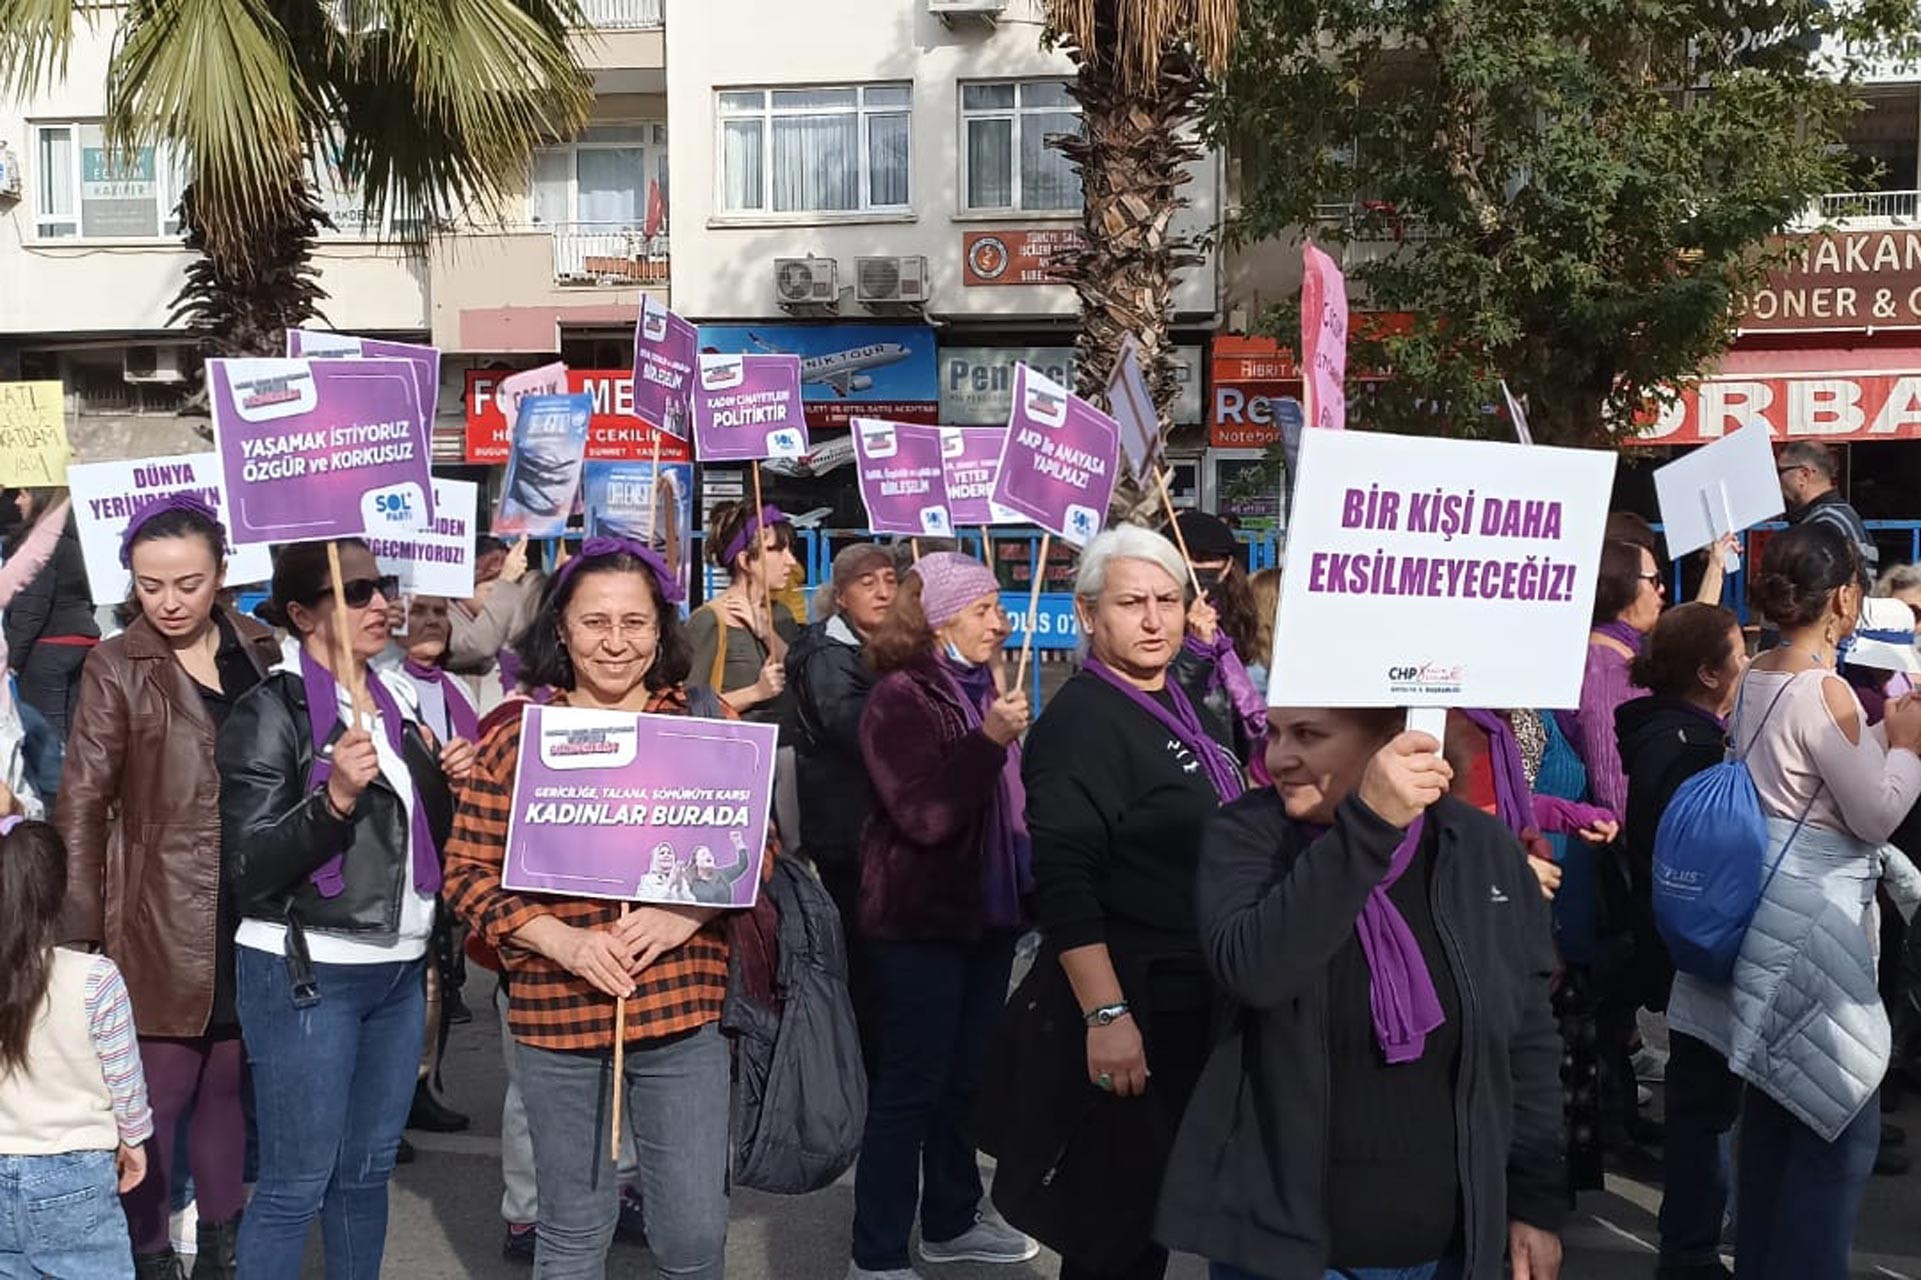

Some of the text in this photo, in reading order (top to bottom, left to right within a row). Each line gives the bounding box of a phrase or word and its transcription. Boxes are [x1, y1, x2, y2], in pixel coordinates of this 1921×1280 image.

[713, 403, 787, 428] POLİTİKTİR
[241, 420, 410, 460] YAŞAMAK İSTİYORUZ
[242, 442, 414, 482] ÖZGÜR ve KORKUSUZ
[133, 463, 196, 489] DÜNYA
[375, 492, 411, 513] SOL
[1341, 483, 1563, 542] BİR KİŞİ DAHA
[1308, 548, 1577, 602] EKSİLMEYECEĞİZ!
[1388, 667, 1418, 680] CHP
[525, 803, 750, 828] KADINLAR BURADA
